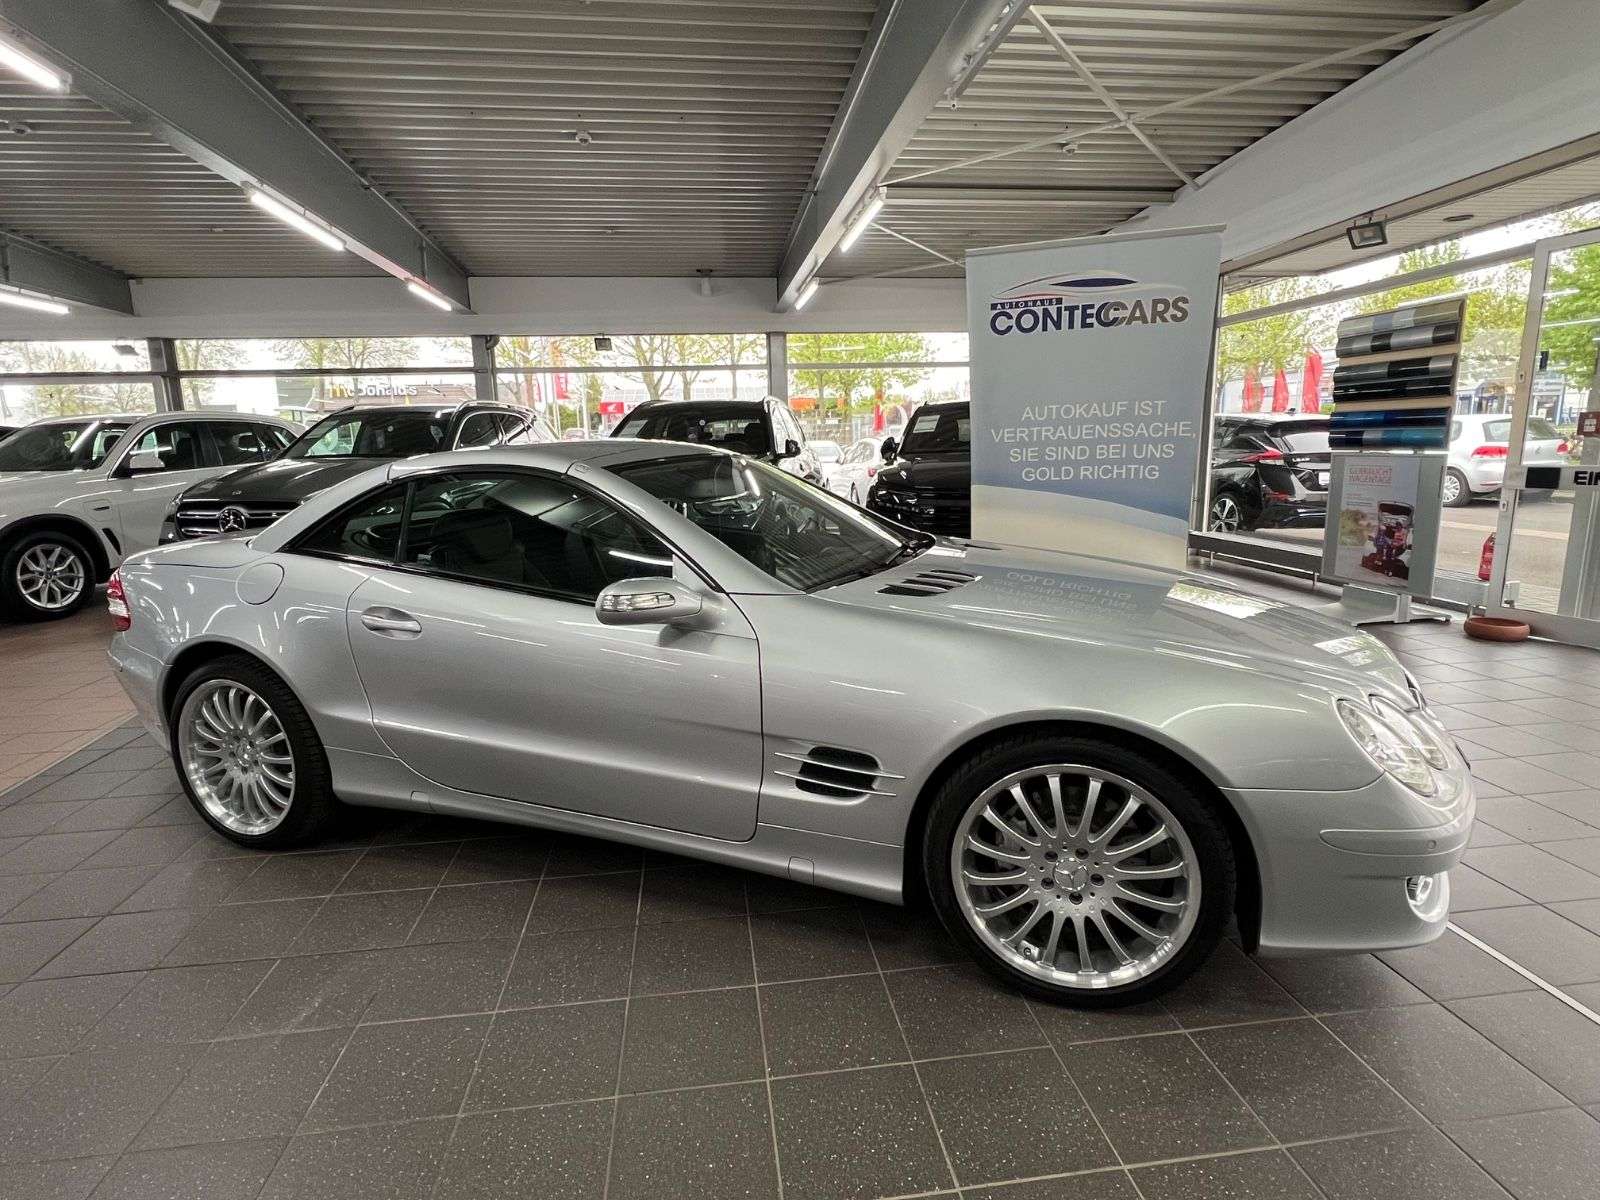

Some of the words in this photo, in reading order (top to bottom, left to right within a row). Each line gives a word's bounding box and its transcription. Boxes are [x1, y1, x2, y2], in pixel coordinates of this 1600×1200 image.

[996, 299, 1057, 310] AUTOHAUS
[1021, 401, 1128, 421] AUTOKAUF
[1135, 400, 1167, 416] IST
[991, 421, 1197, 443] VERTRAUENSSACHE,
[1009, 448, 1040, 463] SIE
[1044, 446, 1089, 461] SIND
[1096, 444, 1126, 460] BEI
[1133, 443, 1176, 458] UNS
[1021, 467, 1075, 482] GOLD
[1080, 464, 1160, 480] RICHTIG
